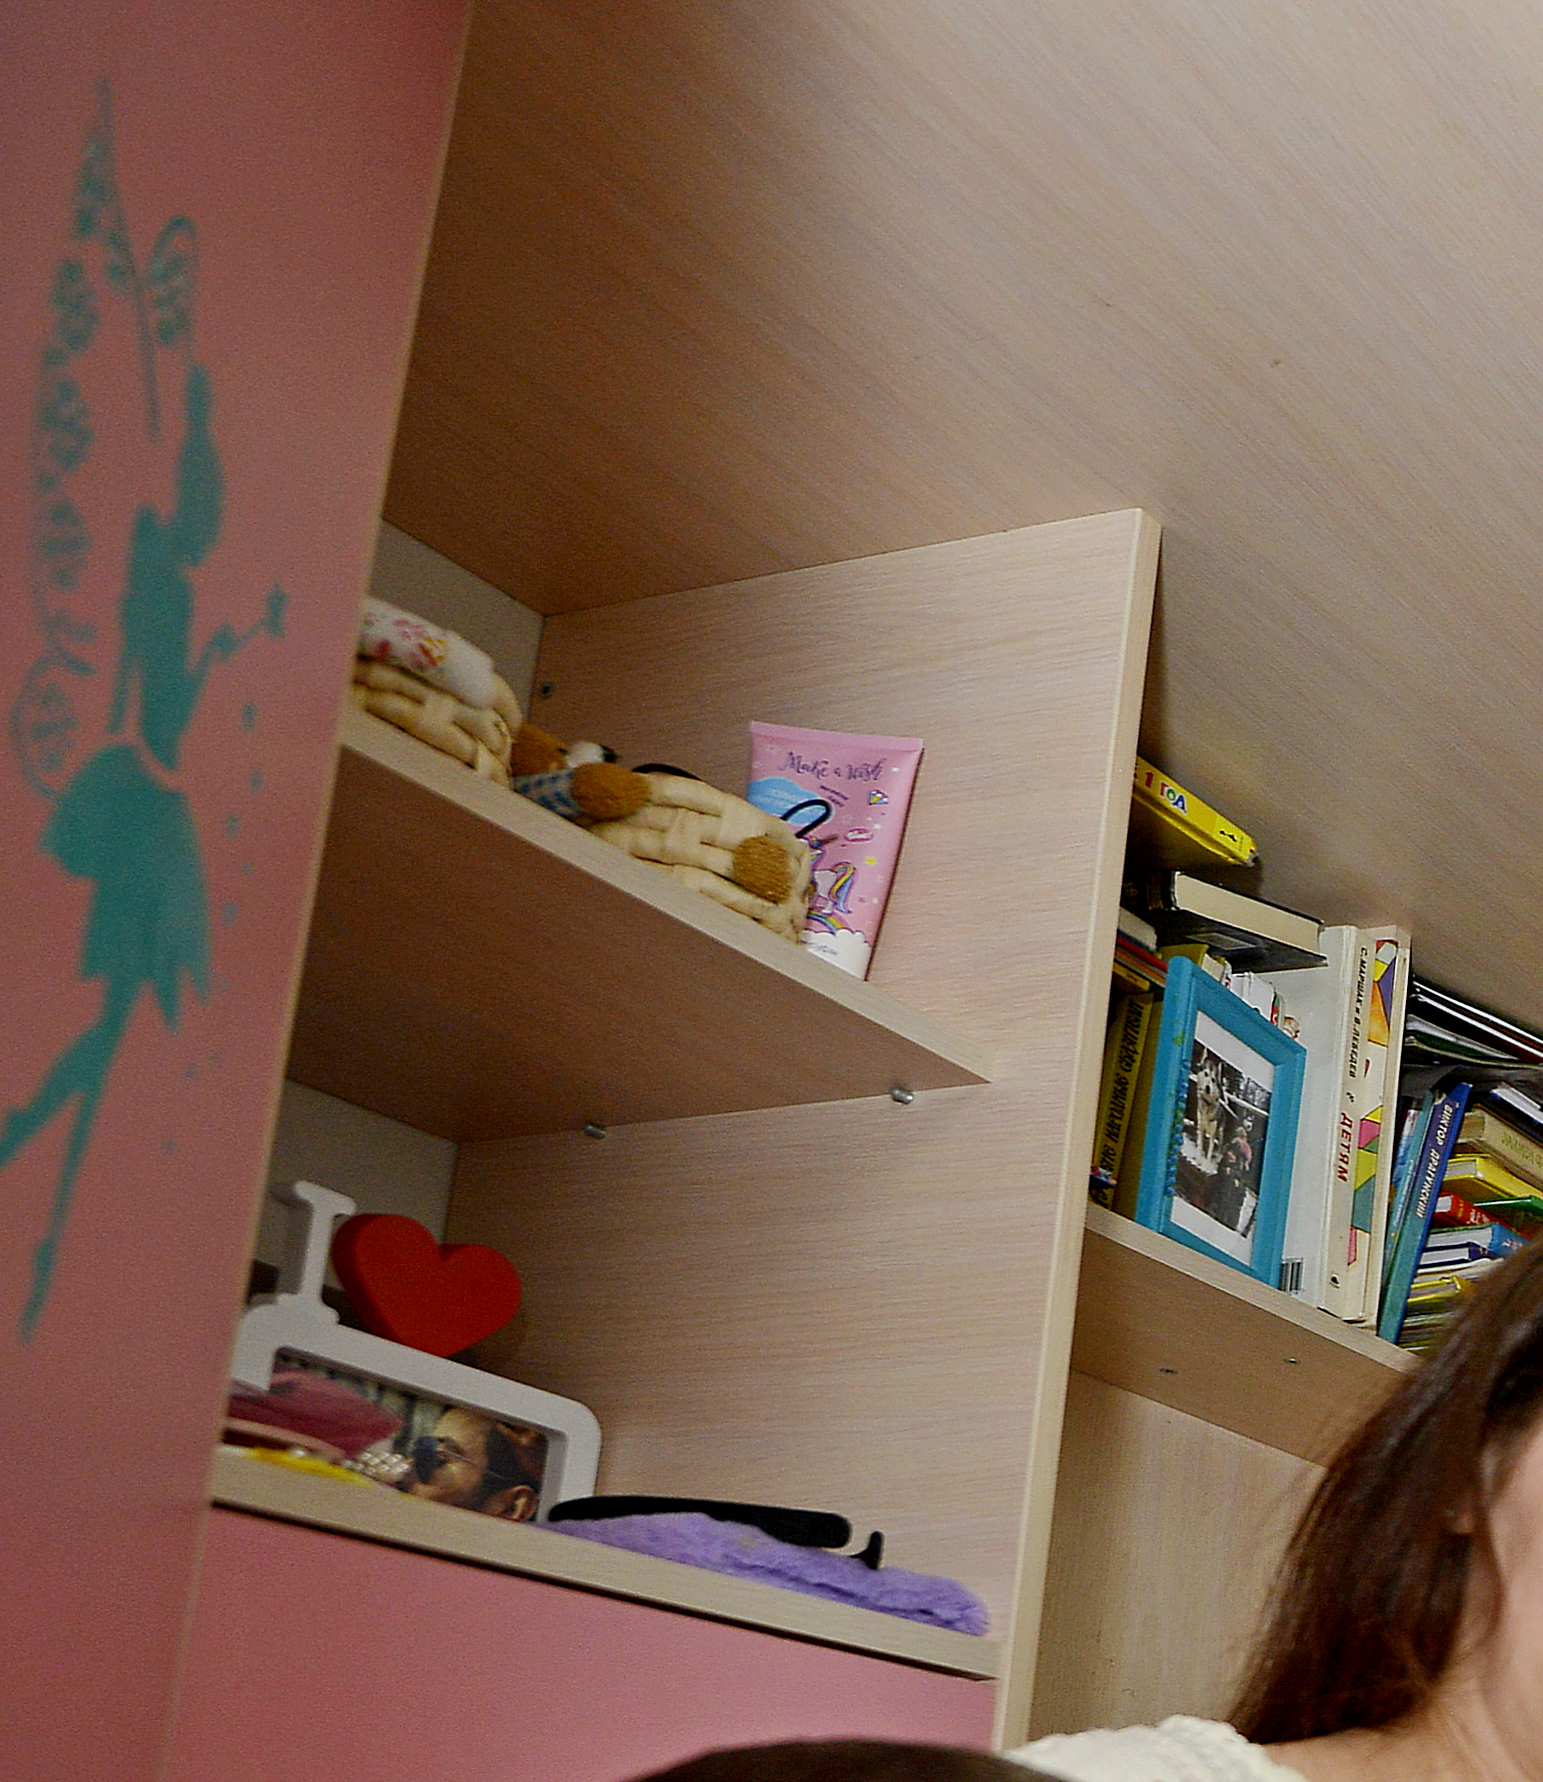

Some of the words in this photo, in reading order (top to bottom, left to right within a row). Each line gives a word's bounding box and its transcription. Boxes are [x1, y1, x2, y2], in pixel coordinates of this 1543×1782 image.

[778, 751, 829, 779] Make
[833, 767, 842, 778] a
[1144, 771, 1155, 788] 1
[1159, 781, 1188, 815] ГОД
[1437, 1104, 1453, 1146] ВИКТОР
[1337, 1112, 1353, 1183] ДЕТЯМ
[1416, 1148, 1440, 1219] ДРАГУНСКИЙ
